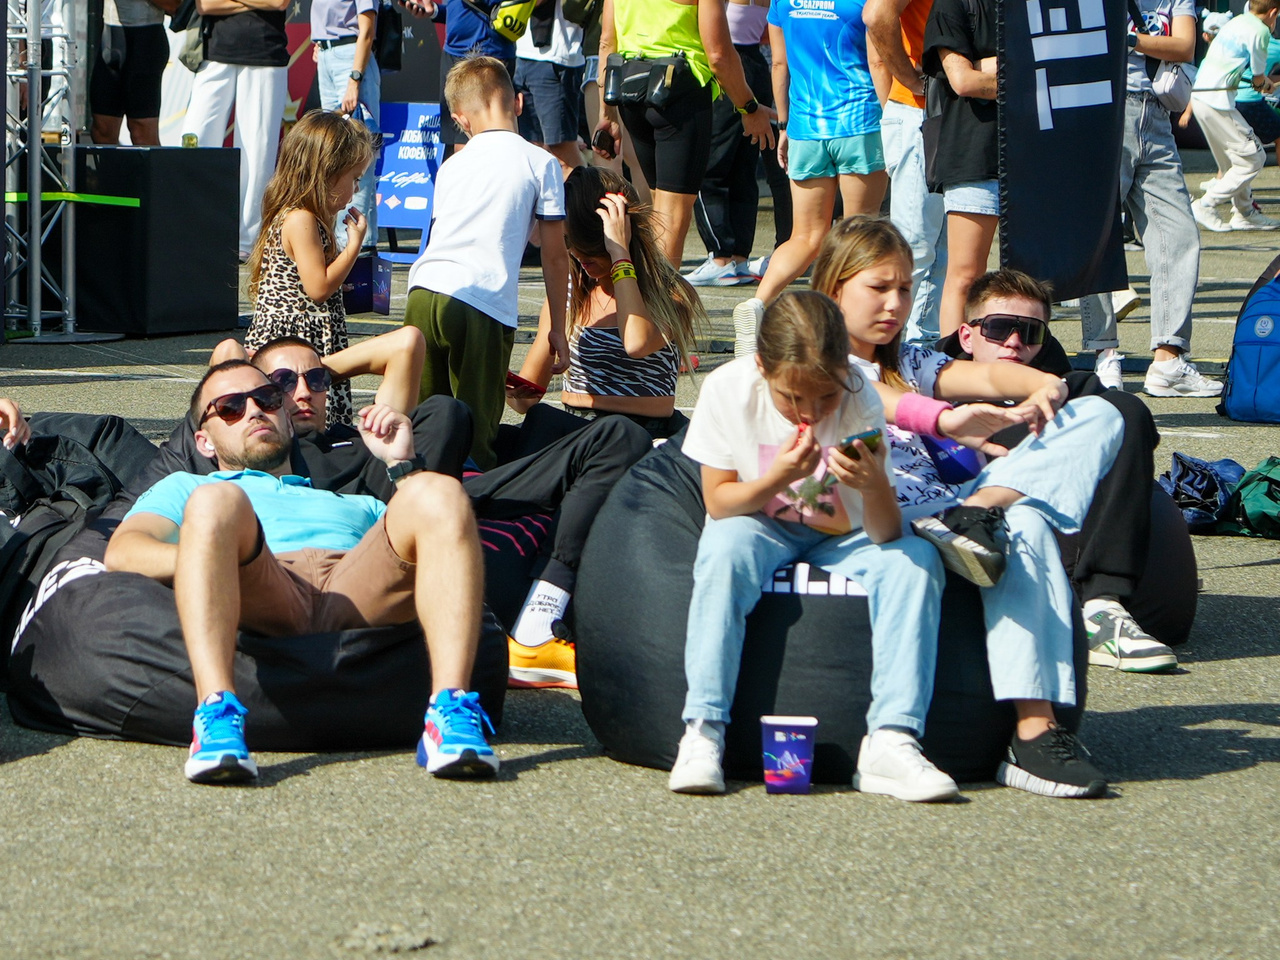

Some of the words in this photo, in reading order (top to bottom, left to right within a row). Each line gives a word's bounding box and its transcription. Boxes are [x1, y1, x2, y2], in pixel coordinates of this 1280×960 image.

[803, 0, 835, 10] GAZPROM
[418, 115, 440, 128] ВАША
[400, 130, 440, 144] ЛЮБИМАЯ
[398, 146, 438, 160] КОФЕЙНЯ
